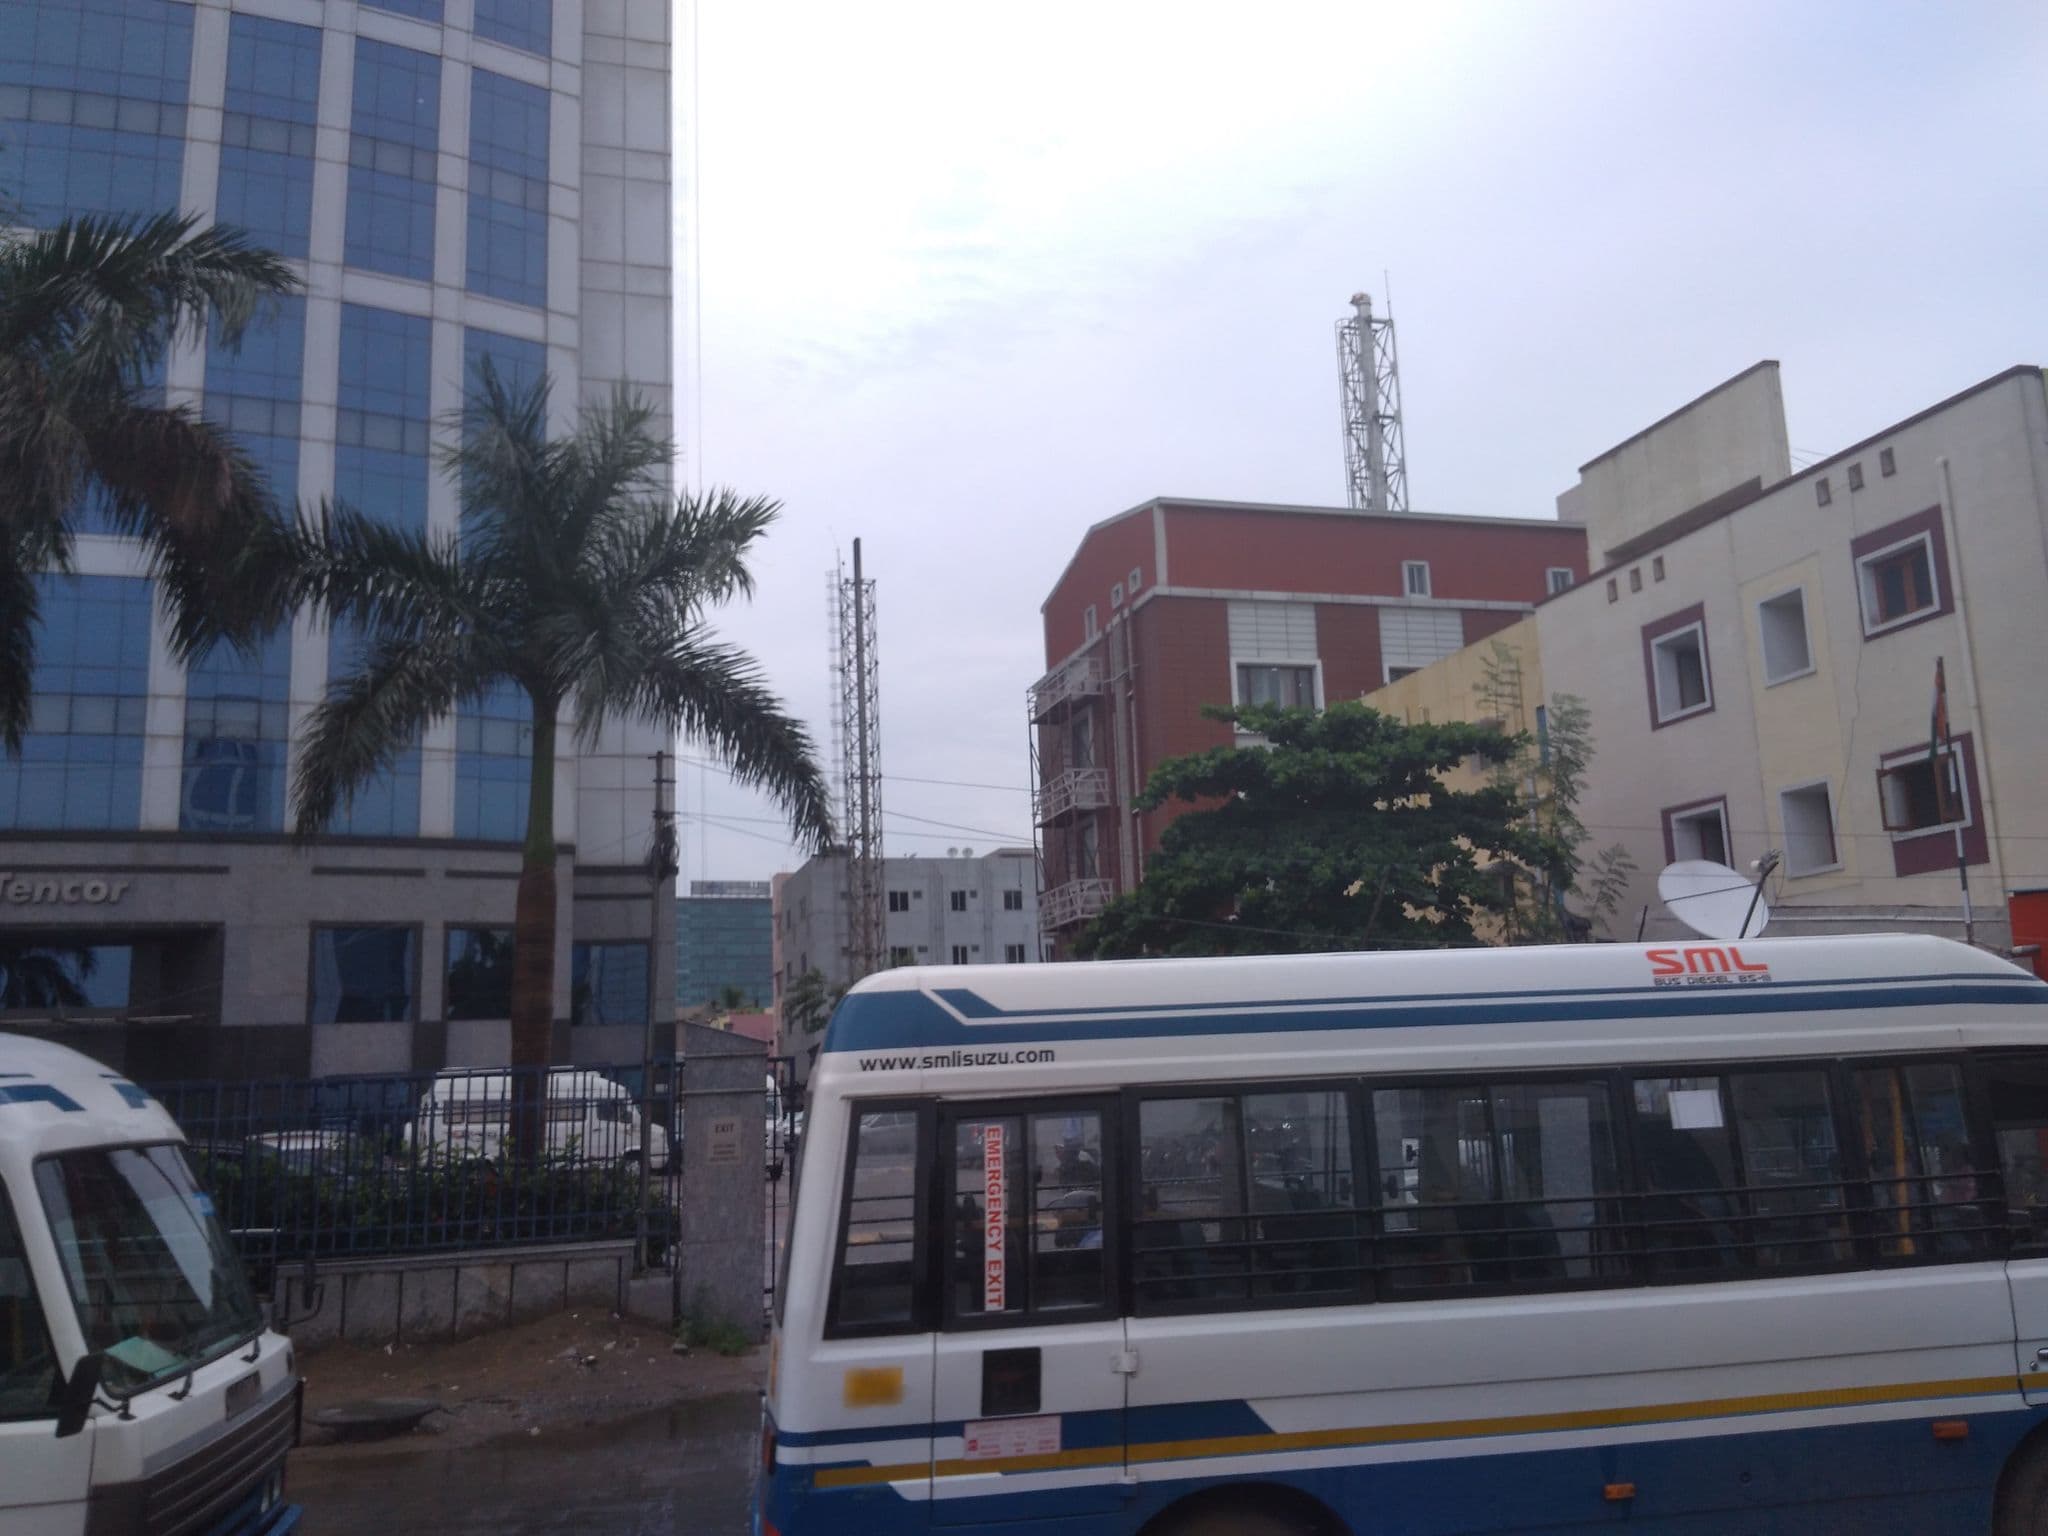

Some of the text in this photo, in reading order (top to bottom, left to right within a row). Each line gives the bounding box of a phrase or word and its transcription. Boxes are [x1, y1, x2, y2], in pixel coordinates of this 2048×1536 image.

[1646, 947, 1769, 975] SML
[859, 1049, 1055, 1071] www.smlisuzu.com
[986, 1127, 1003, 1306] EMERGENCY EXIT
